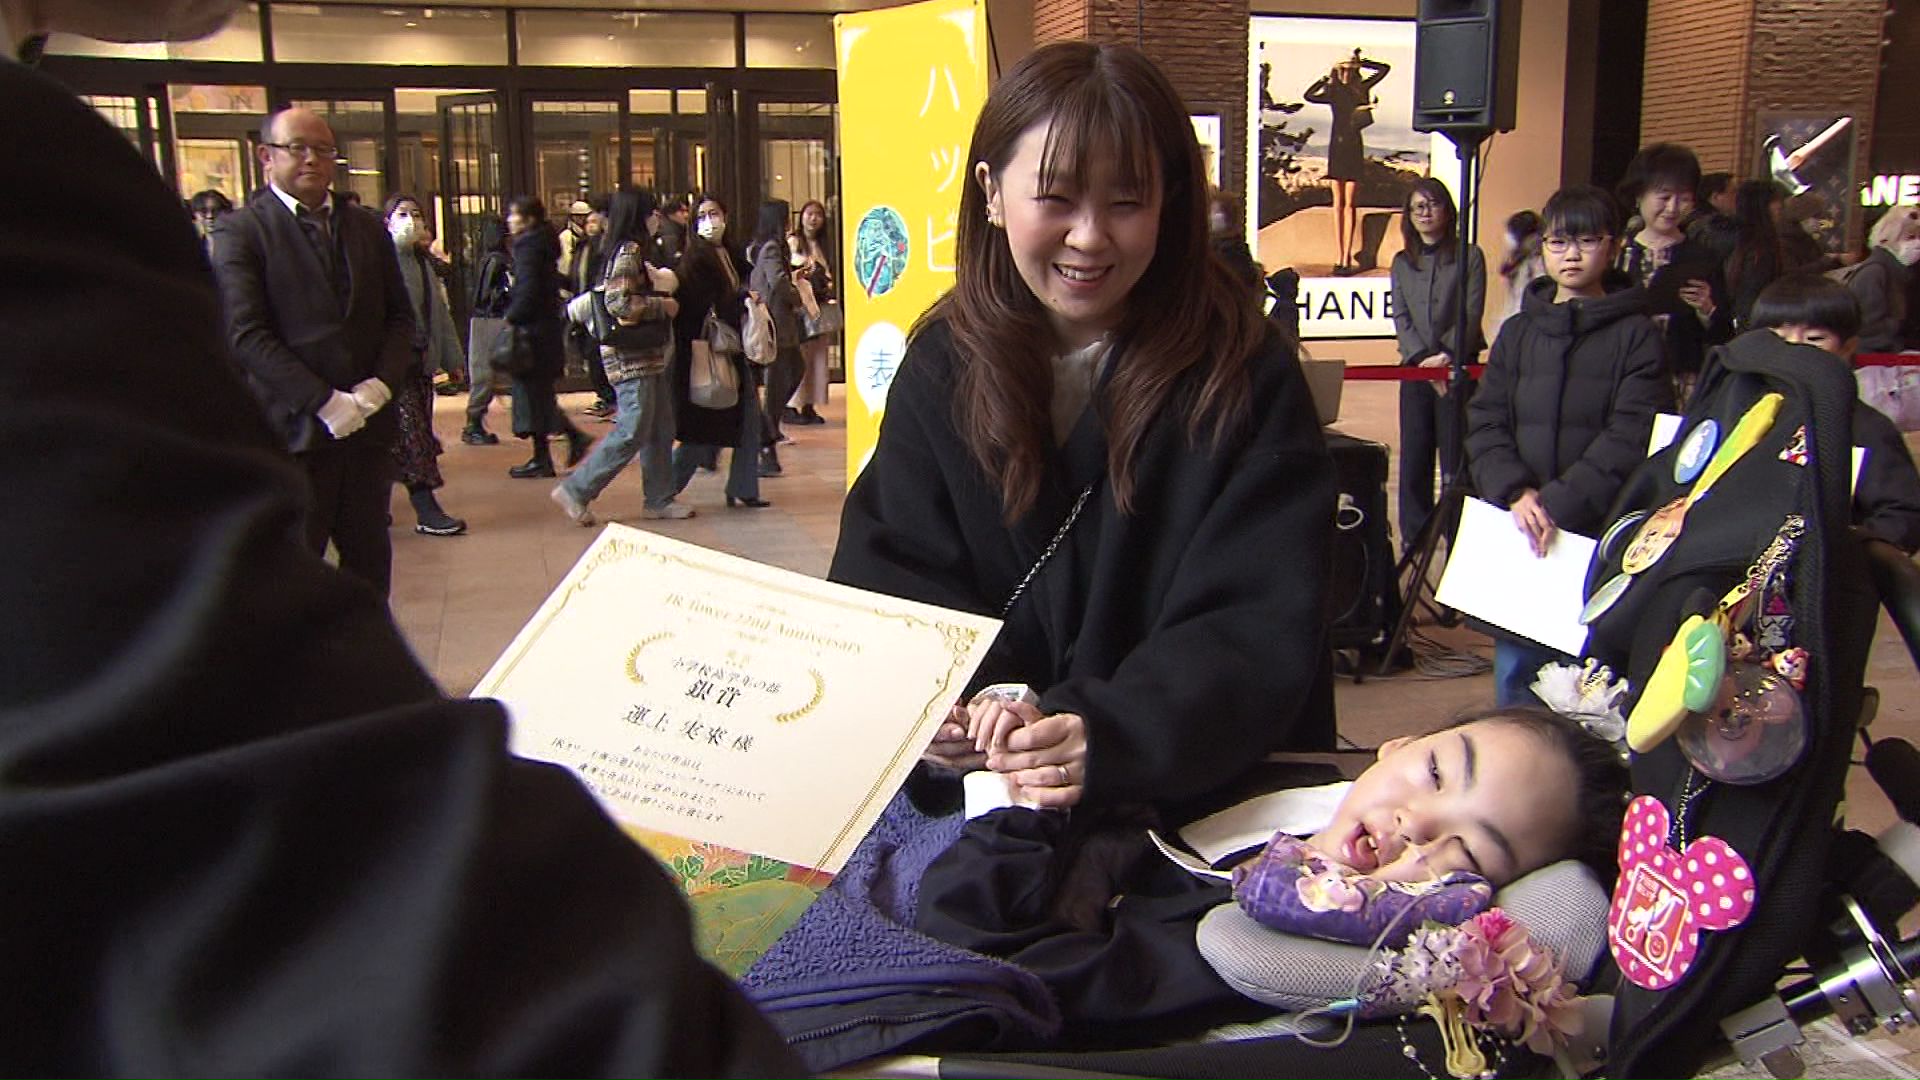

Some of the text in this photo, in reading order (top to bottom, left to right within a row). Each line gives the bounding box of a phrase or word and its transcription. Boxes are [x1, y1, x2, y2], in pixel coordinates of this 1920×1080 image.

[1264, 290, 1393, 320] HANE
[867, 348, 894, 390] 表
[776, 622, 862, 654] Anniversary
[685, 678, 742, 708] 銀賞
